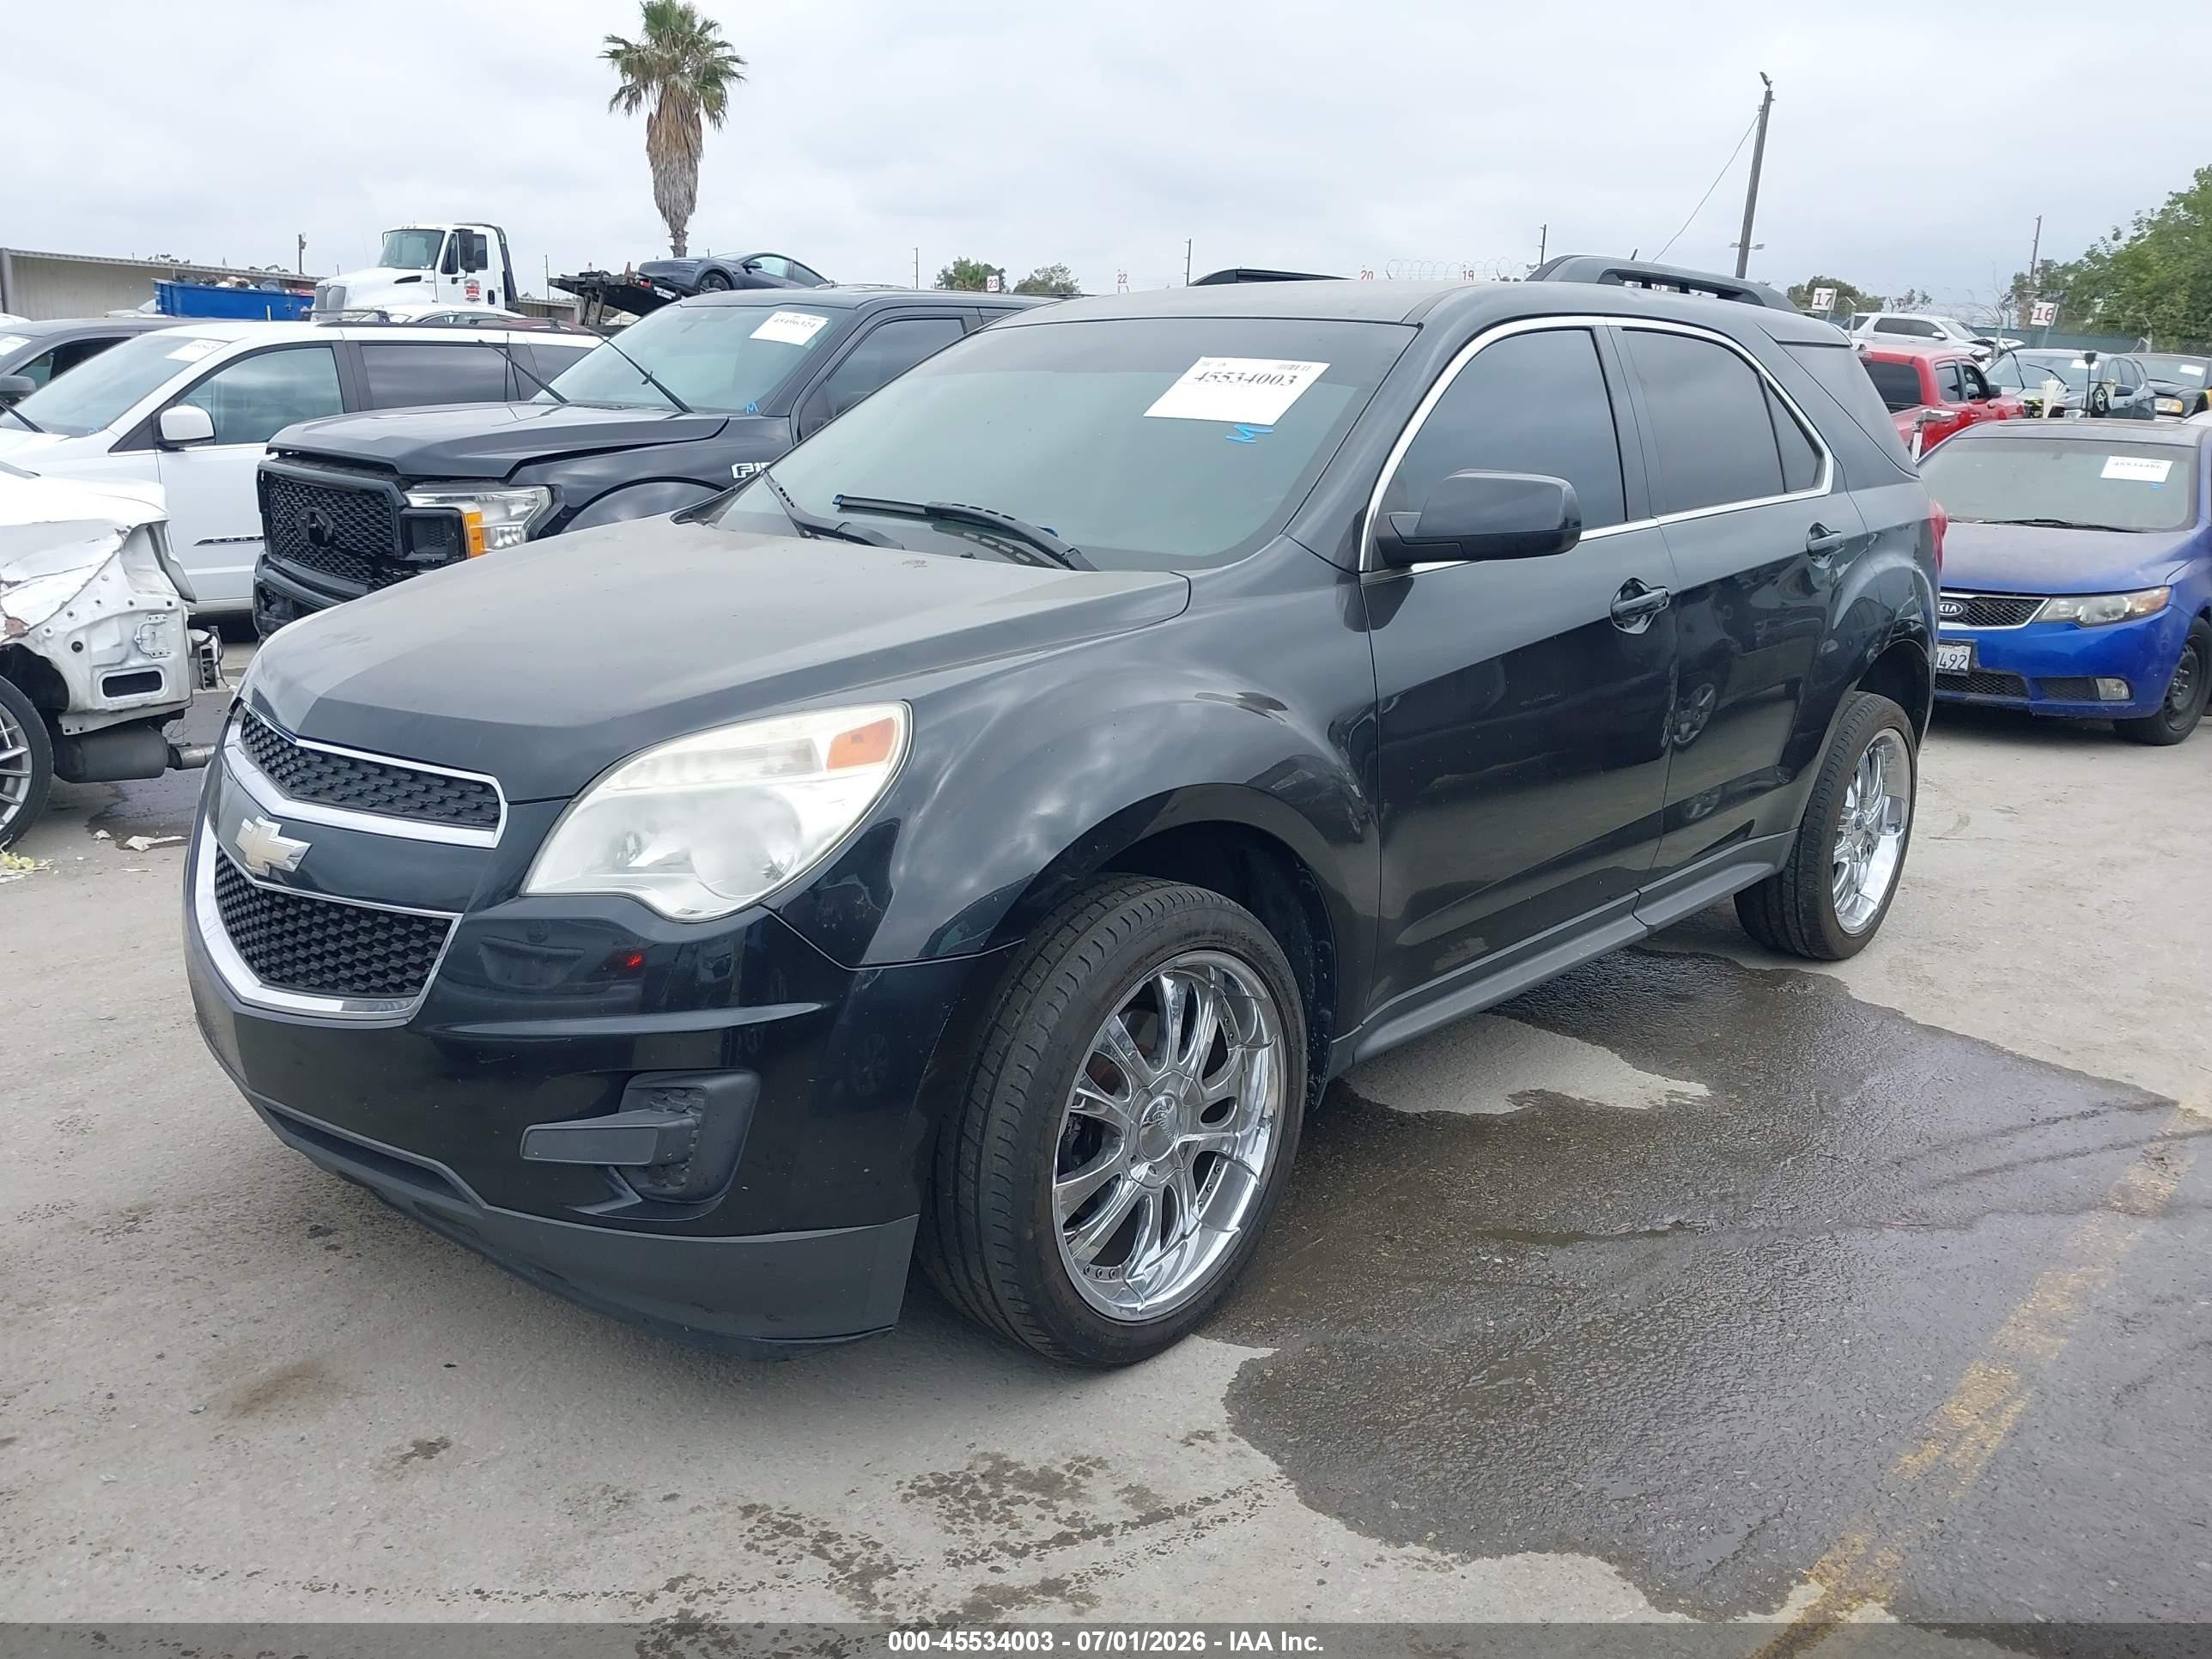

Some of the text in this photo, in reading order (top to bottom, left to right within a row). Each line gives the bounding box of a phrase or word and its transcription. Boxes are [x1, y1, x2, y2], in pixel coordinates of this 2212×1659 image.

[988, 278, 999, 289] 23
[1117, 273, 1127, 284] 22
[1813, 292, 1833, 307] 17
[2033, 307, 2054, 322] 16
[1194, 371, 1298, 386] 45534003
[1940, 604, 1957, 613] KIA
